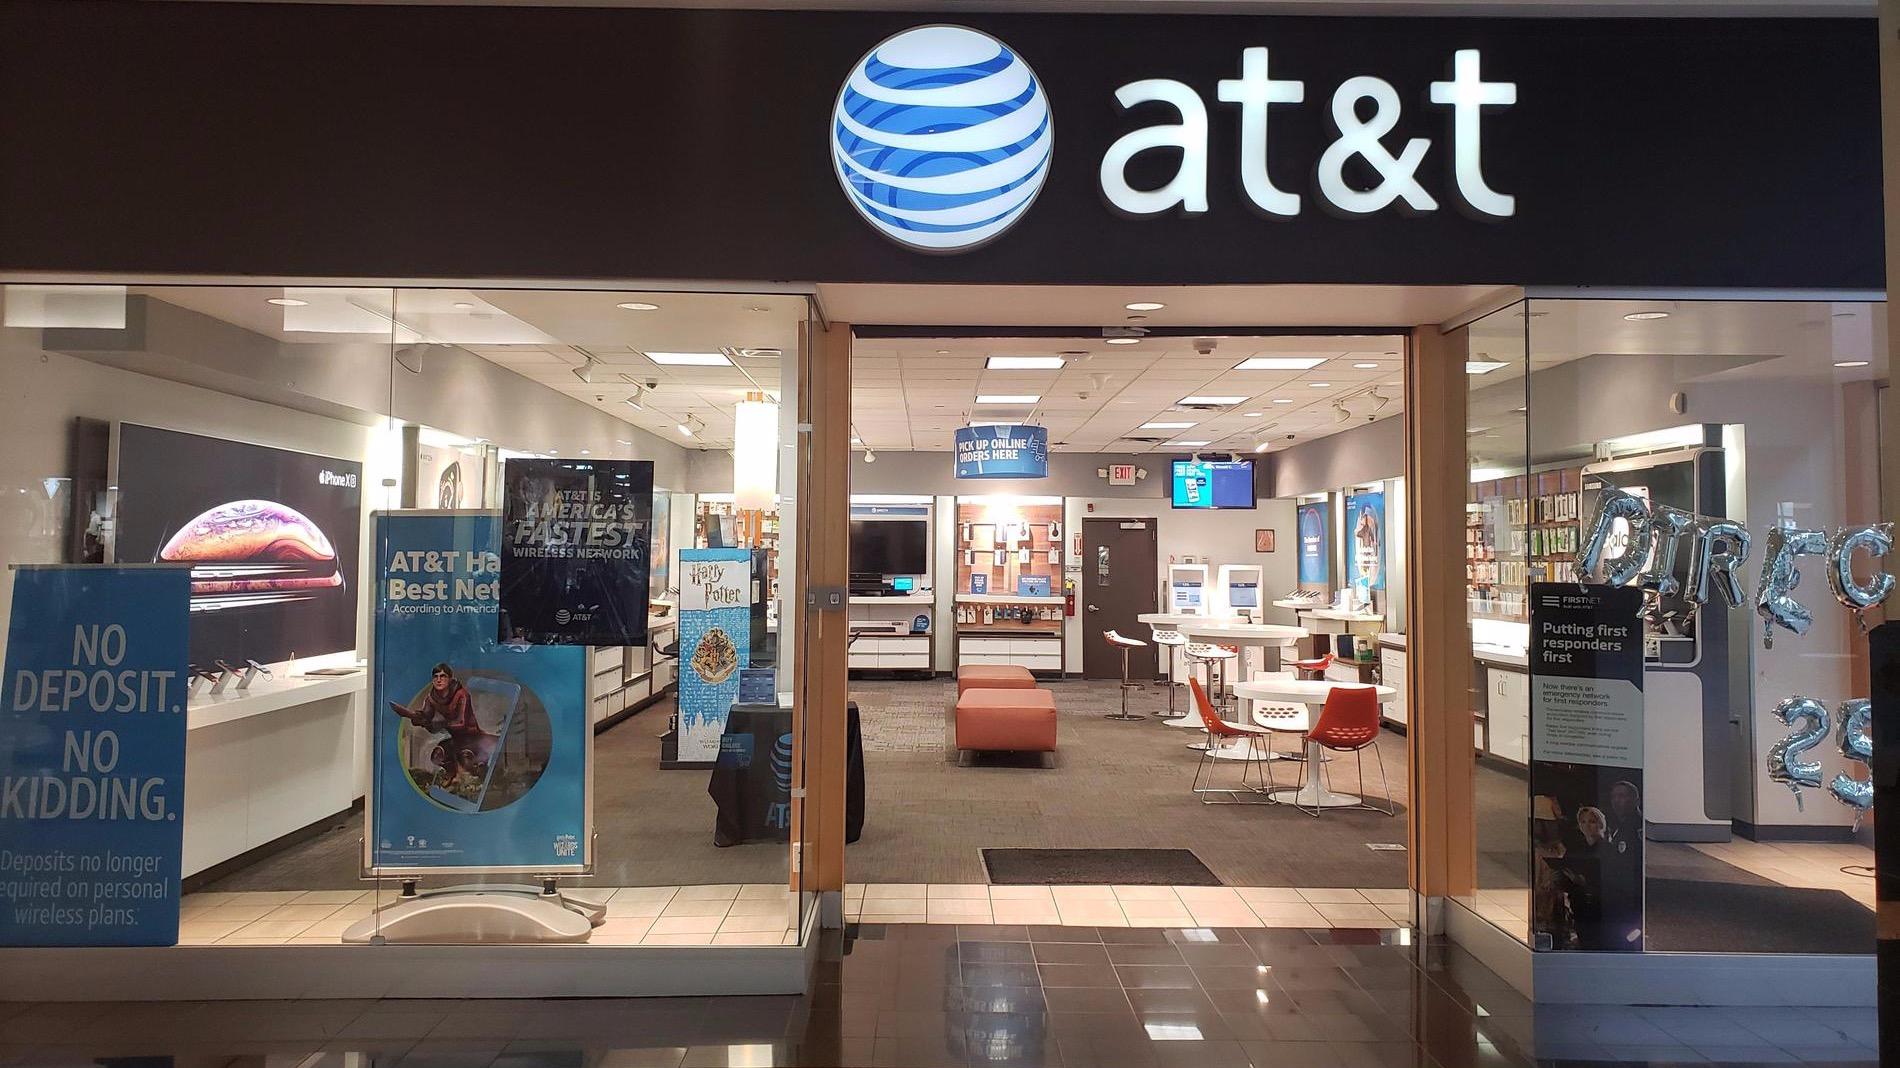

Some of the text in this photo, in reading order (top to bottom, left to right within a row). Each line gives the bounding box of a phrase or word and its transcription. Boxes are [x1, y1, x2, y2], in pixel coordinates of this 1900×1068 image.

[1099, 46, 1517, 218] at&t
[958, 438, 1027, 453] PICK UP ONLINE
[959, 449, 1019, 463] ORDERS HERE
[325, 470, 345, 486] iPhone
[1114, 466, 1132, 480] EXIT
[555, 490, 587, 501] AT&T
[526, 502, 635, 520] AMERICA'S
[513, 521, 643, 547] FASTEST
[390, 550, 459, 573] AT&T
[513, 547, 640, 560] WIRELESS NETWORK
[689, 562, 725, 587] Harry
[389, 578, 448, 601] Best
[704, 582, 741, 608] Potter
[392, 603, 440, 616] According
[443, 604, 454, 614] to
[572, 613, 592, 621] AT&T
[1542, 621, 1628, 638] Putting first
[72, 623, 127, 667] NO
[1542, 638, 1622, 653] responders
[1542, 650, 1573, 664] first
[13, 669, 181, 713] DEPOSIT.
[1542, 682, 1559, 690] Now
[63, 730, 120, 774] NO
[0, 776, 176, 821] KIDDING.
[1, 850, 162, 878] Deposits no longer
[0, 876, 168, 904] equired on personal
[15, 902, 84, 925] wireless
